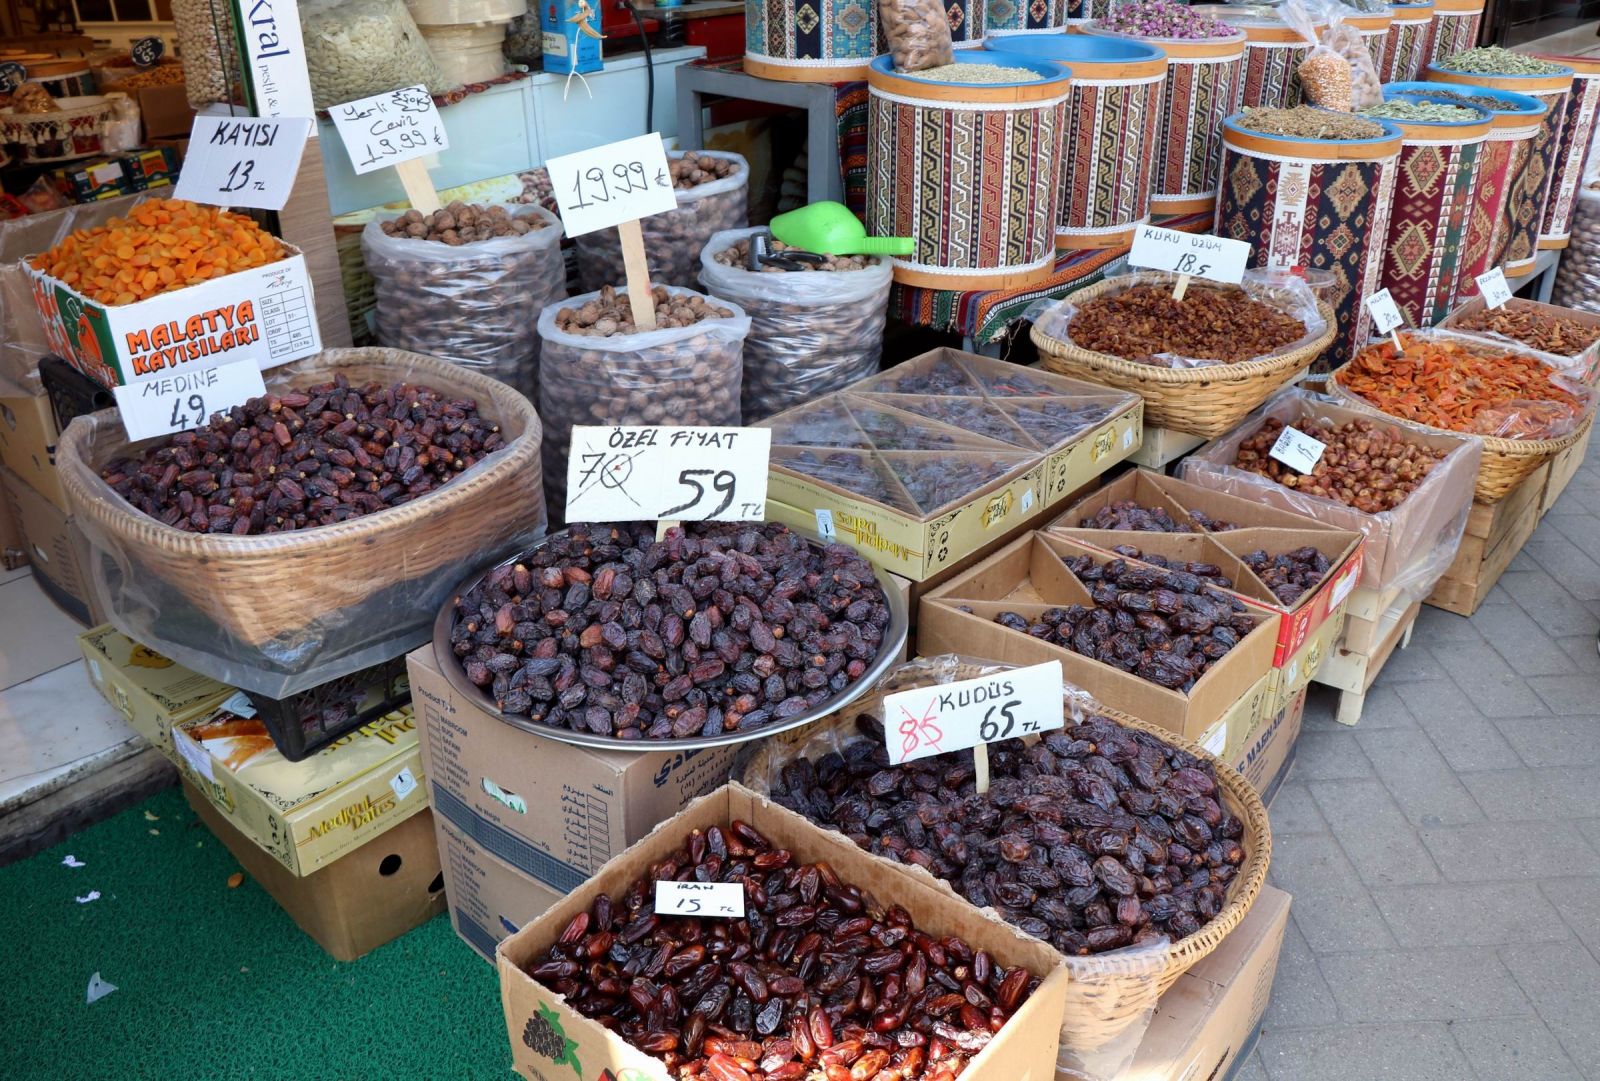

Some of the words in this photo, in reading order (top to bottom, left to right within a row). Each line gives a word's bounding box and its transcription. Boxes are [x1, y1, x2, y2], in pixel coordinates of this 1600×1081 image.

[210, 121, 279, 146] KAYISI
[361, 130, 427, 166] 19.99
[219, 160, 255, 192] 13
[254, 181, 265, 190] TL
[568, 162, 648, 210] 19.99
[1144, 229, 1180, 244] KURU
[126, 300, 255, 355] MALATYA
[132, 323, 259, 376] KAYISILARI
[170, 394, 206, 429] 49
[608, 427, 659, 449] ÖZEL
[658, 469, 736, 521] 59
[741, 503, 762, 517] TL
[939, 681, 1015, 713] KUDÜS
[980, 700, 1022, 742] 65
[1022, 721, 1041, 732] TL
[352, 798, 396, 832] Dates
[676, 898, 701, 913] 15
